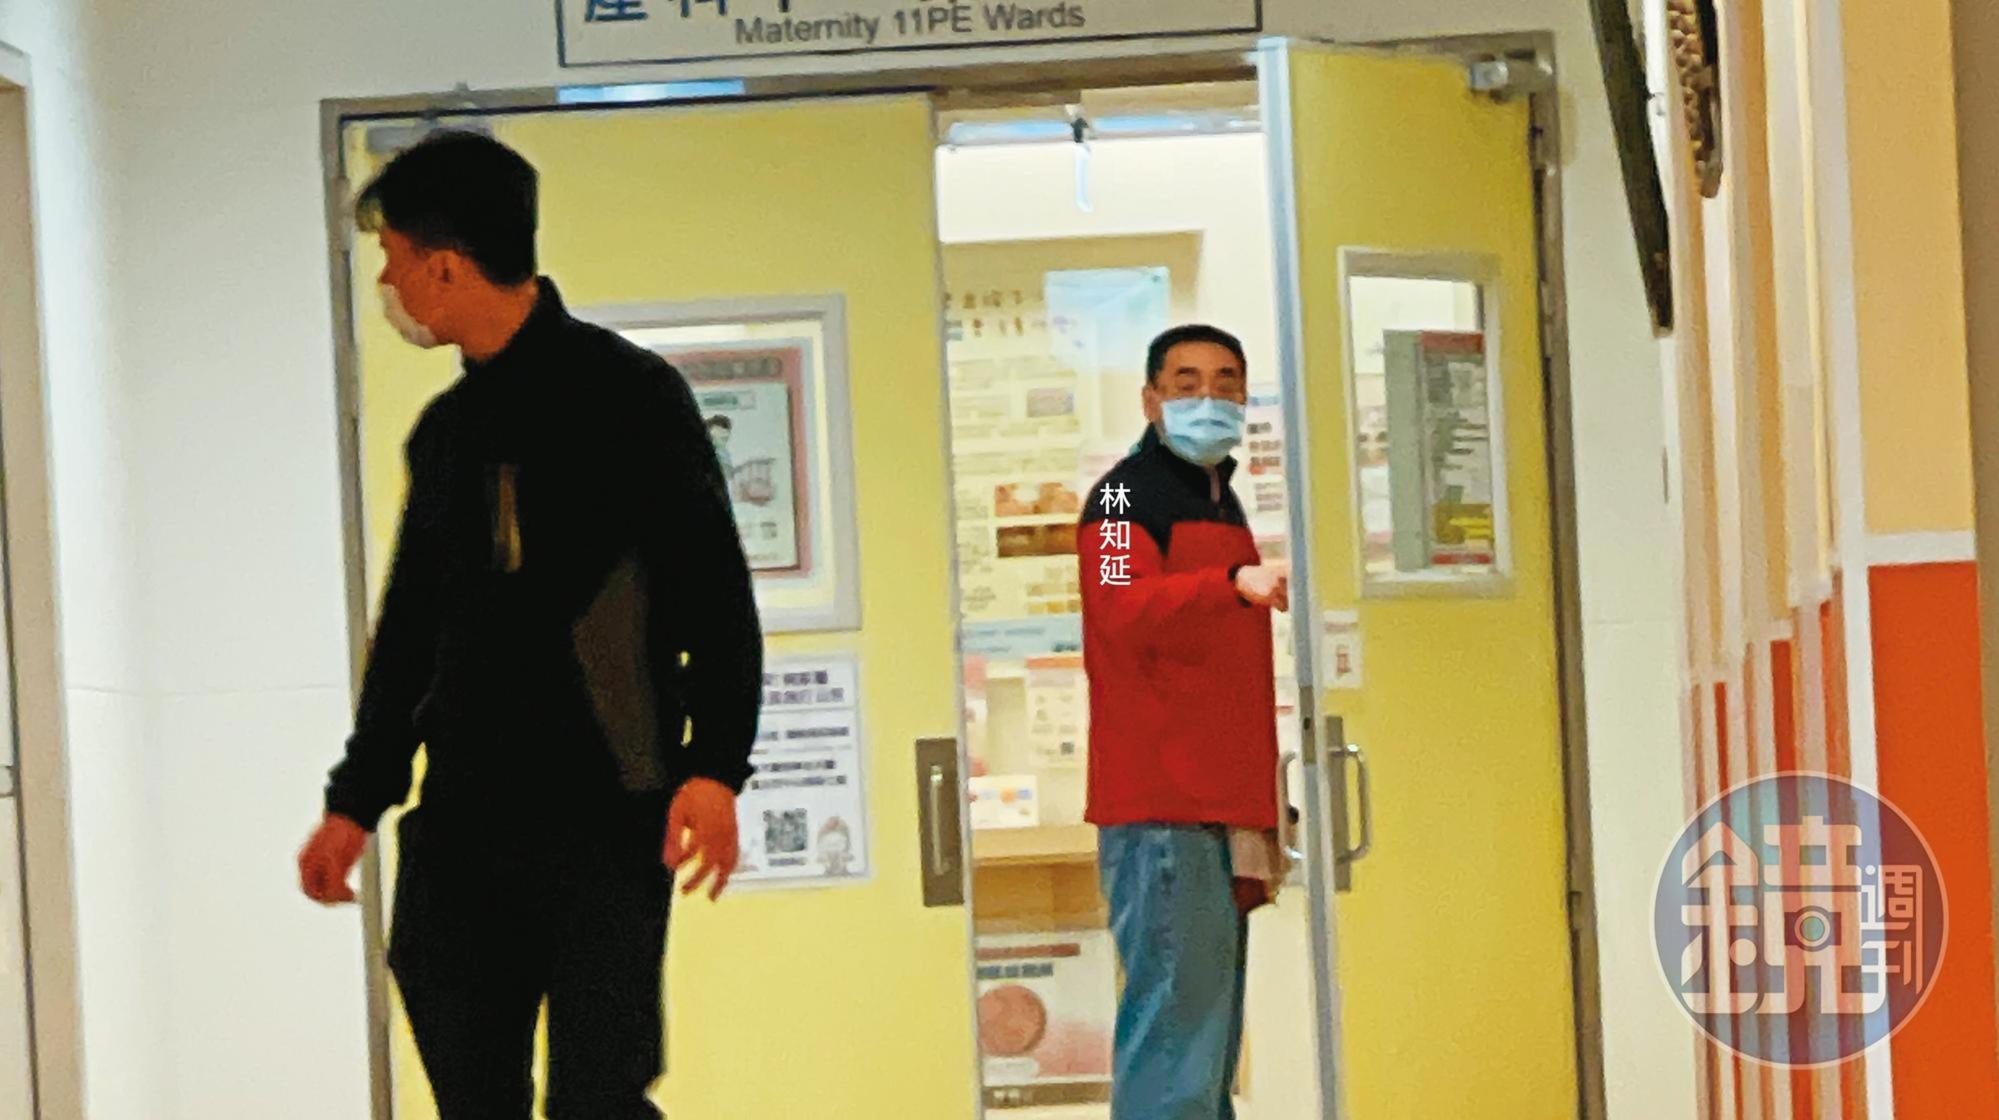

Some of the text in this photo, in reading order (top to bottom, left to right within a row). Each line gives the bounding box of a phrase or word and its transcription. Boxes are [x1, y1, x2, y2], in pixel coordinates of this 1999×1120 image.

[735, 2, 1086, 45] Maternity 11PE Wards
